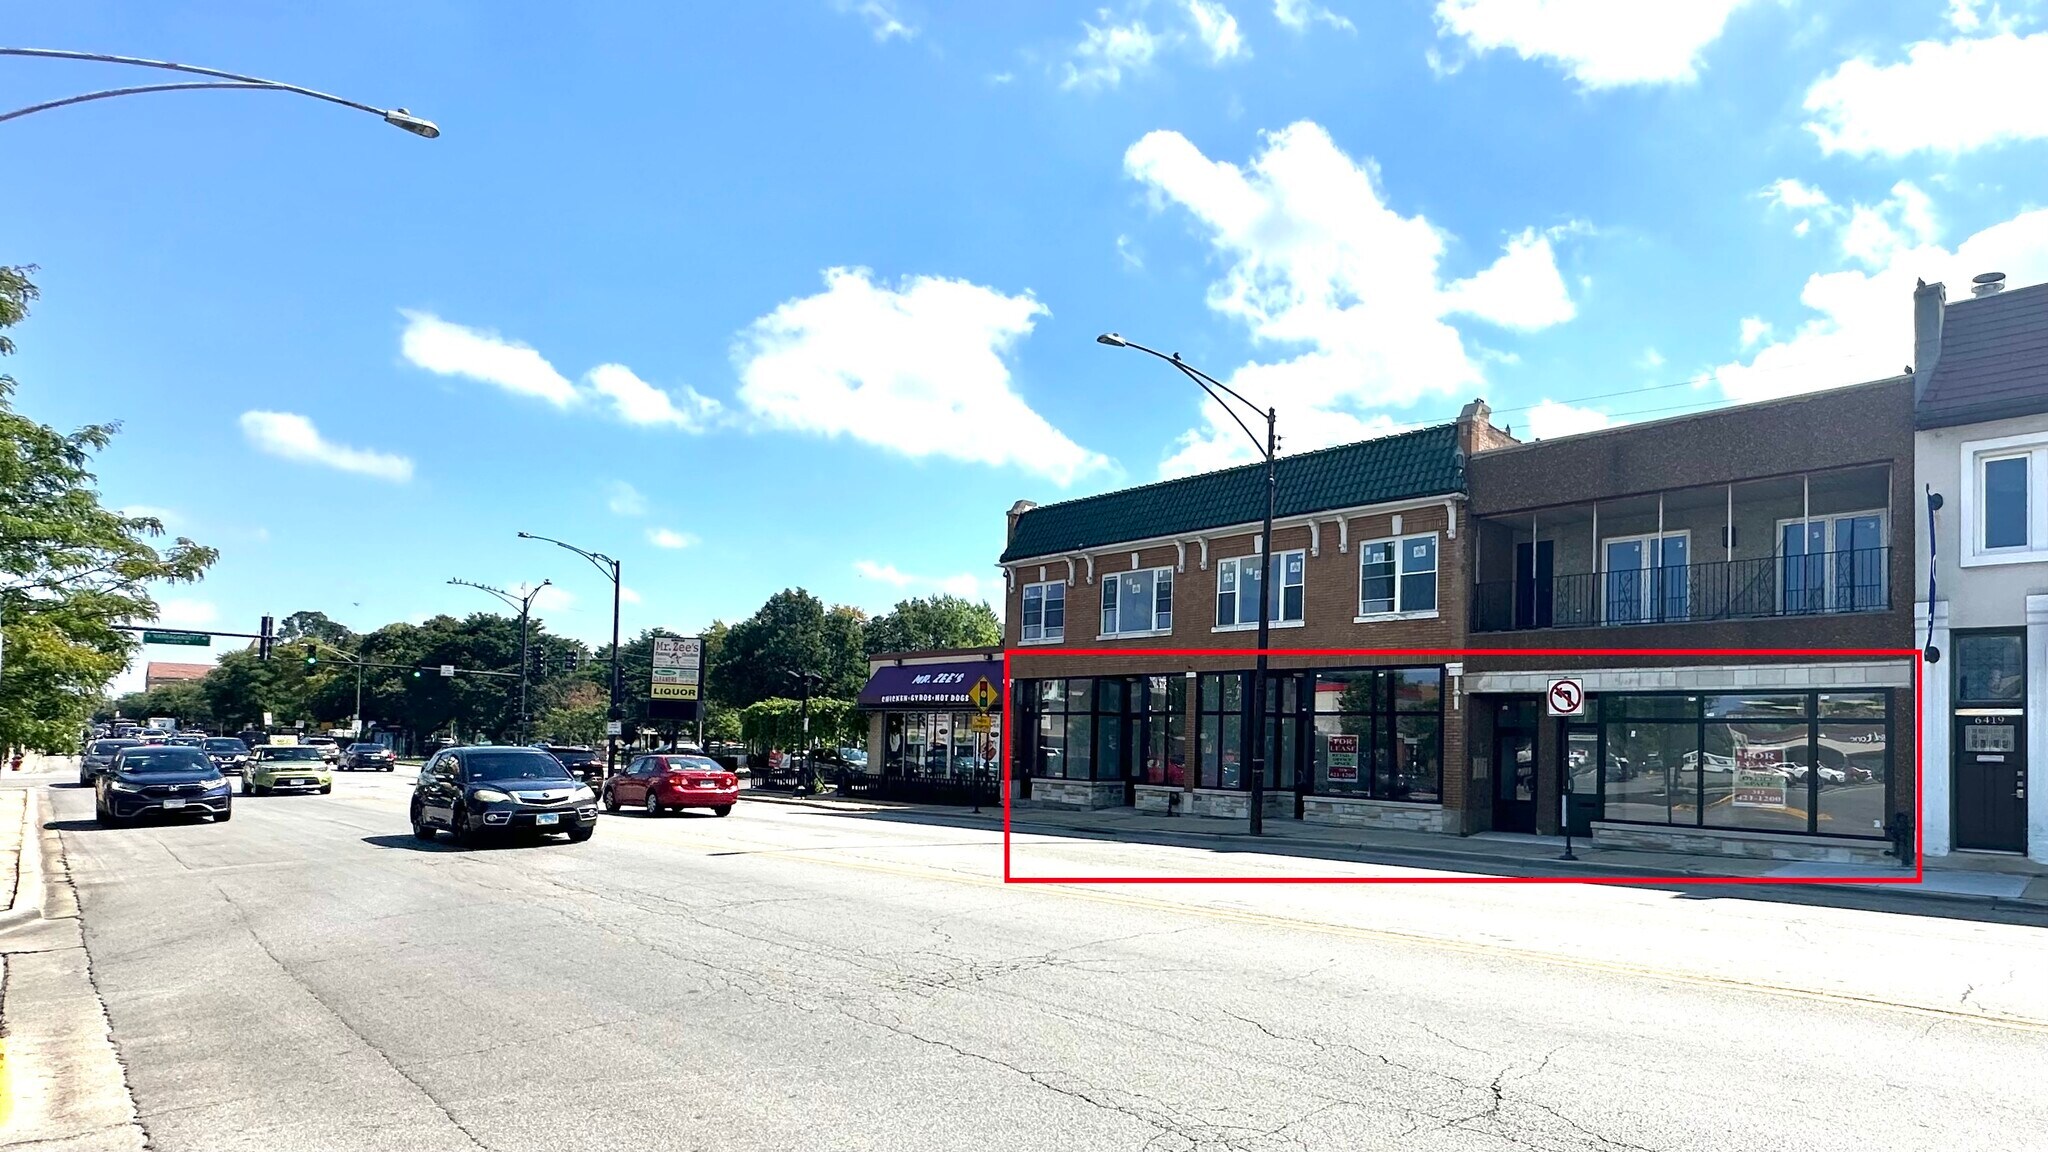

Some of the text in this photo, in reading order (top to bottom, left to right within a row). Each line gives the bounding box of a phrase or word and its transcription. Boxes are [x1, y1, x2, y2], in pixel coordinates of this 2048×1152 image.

[656, 642, 699, 652] Mr. Zee's
[912, 673, 965, 684] MR. ZEE'S
[653, 688, 696, 696] LIQUOR
[950, 694, 969, 702] DOGS
[1974, 716, 2005, 724] 6419
[1743, 751, 1776, 760] FOR
